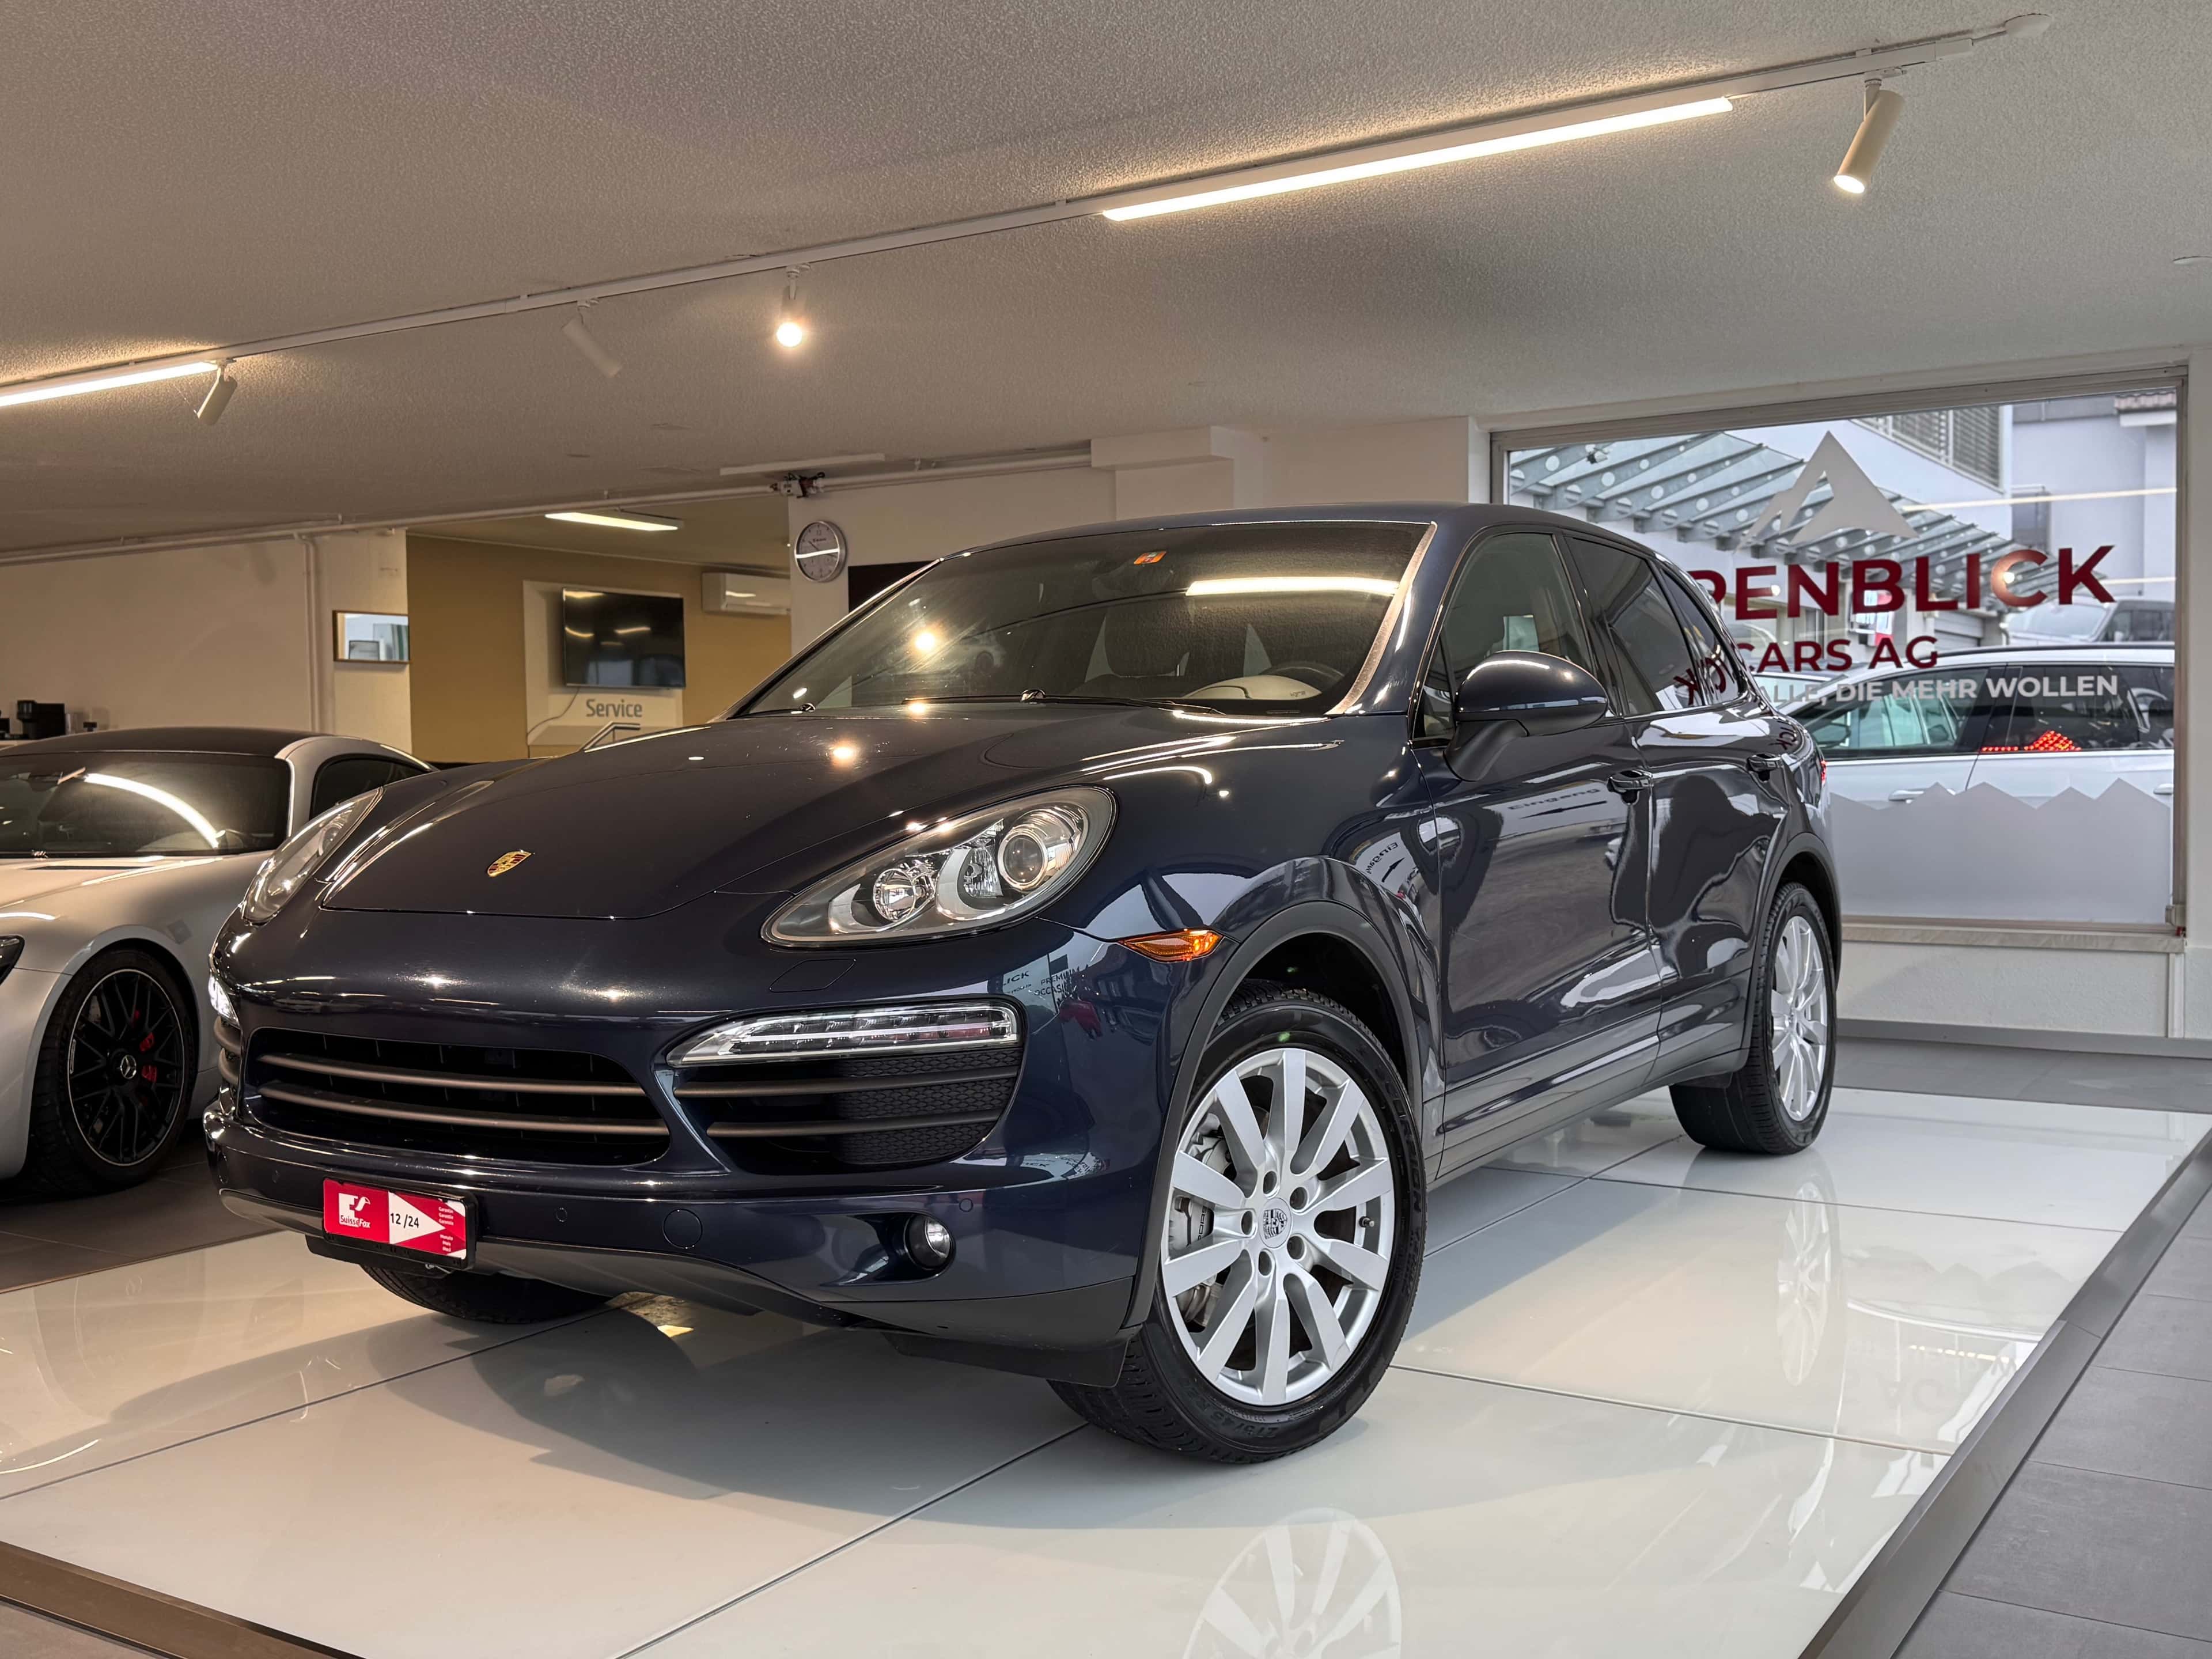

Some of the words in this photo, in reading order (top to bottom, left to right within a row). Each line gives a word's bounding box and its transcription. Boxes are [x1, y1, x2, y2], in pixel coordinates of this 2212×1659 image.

[1868, 635, 1938, 669] AG
[1836, 681, 1884, 702] DIE
[1892, 679, 1978, 700] MEHR
[1986, 675, 2118, 698] WOLLEN
[586, 698, 643, 718] Service
[1003, 970, 1029, 986] ICK
[390, 1213, 401, 1225] 12
